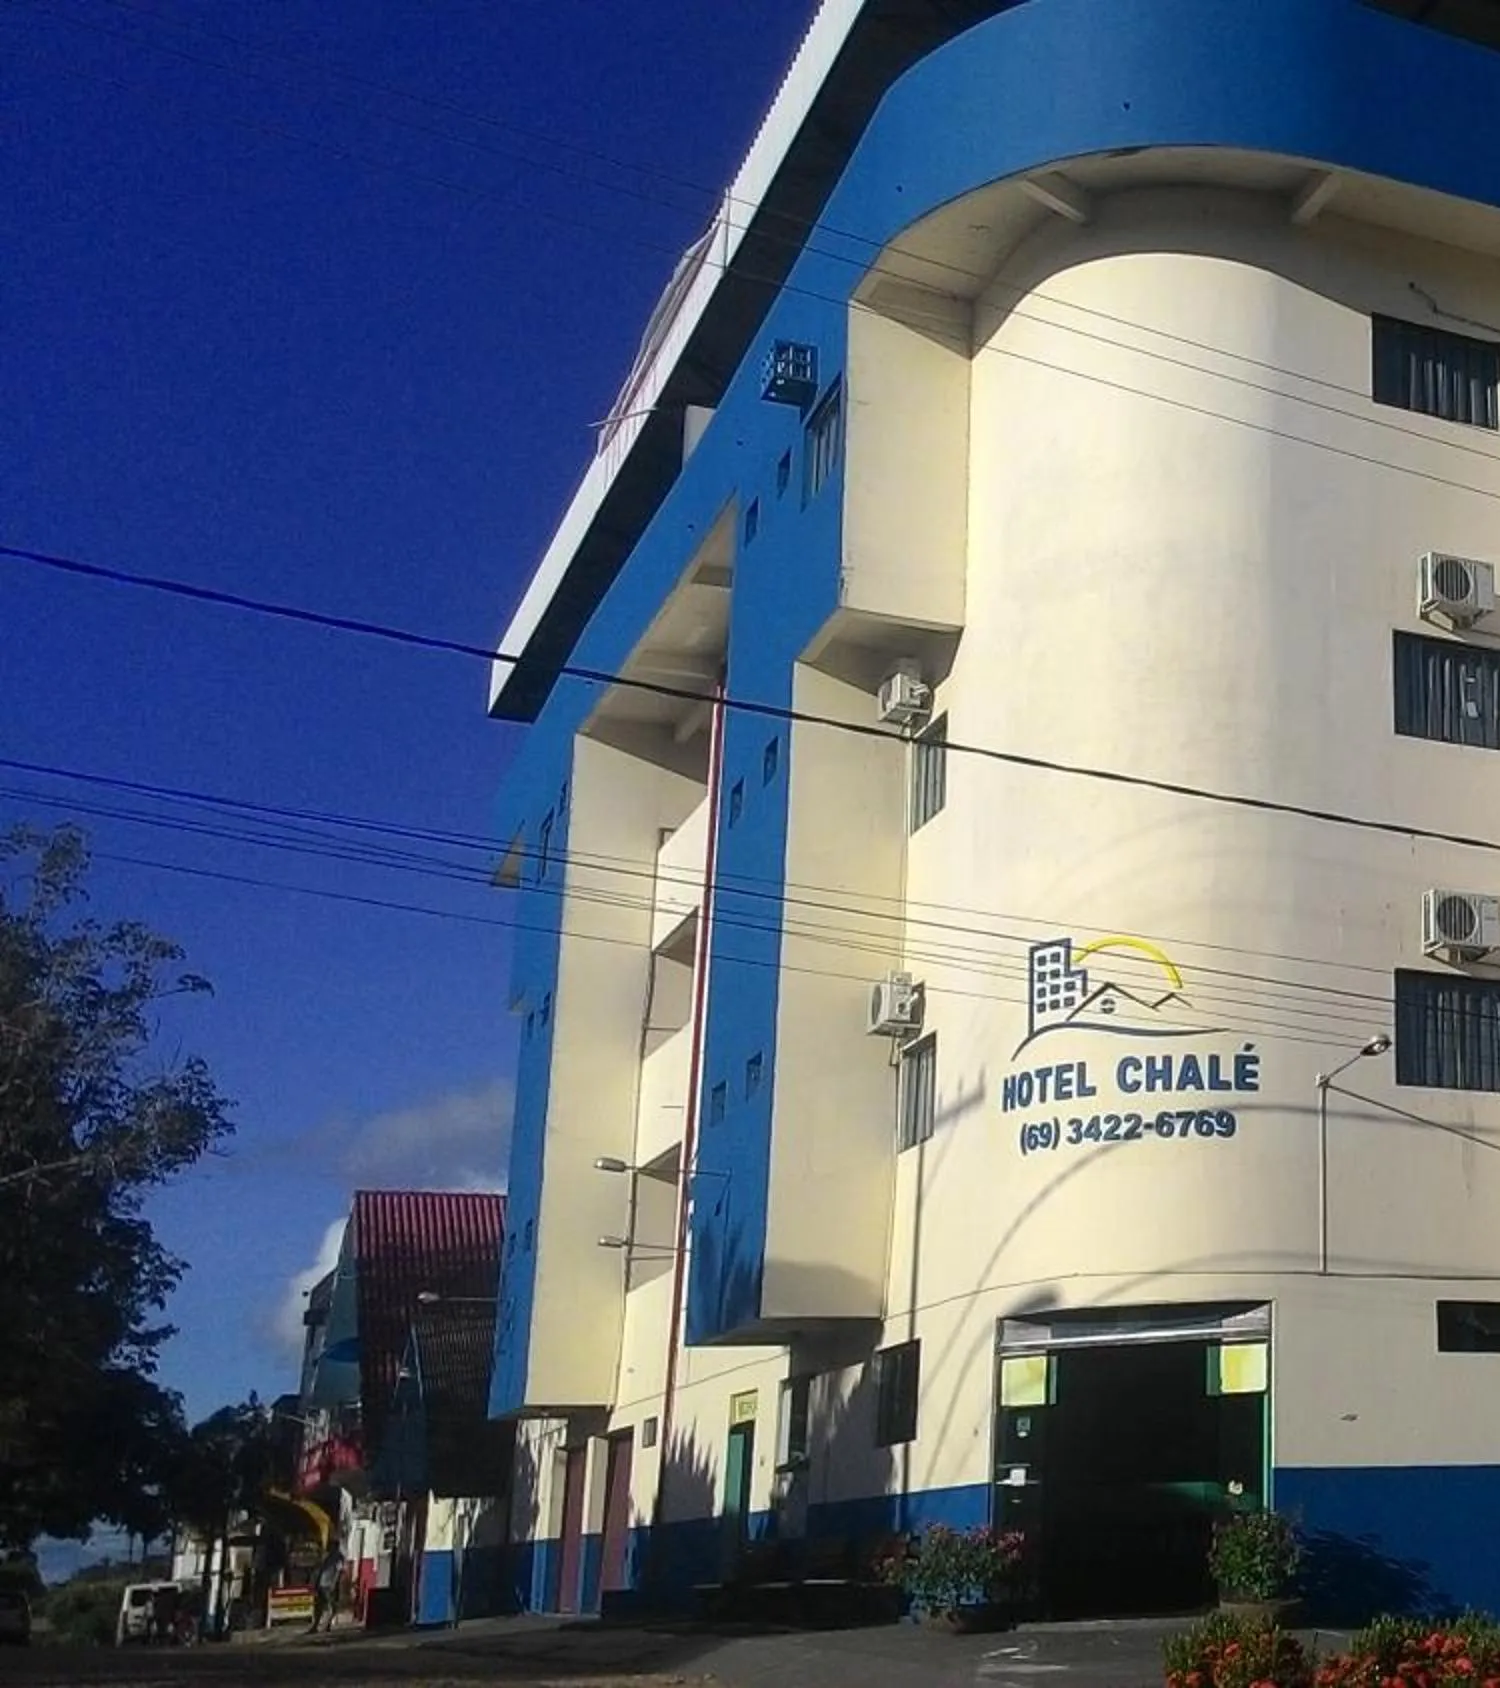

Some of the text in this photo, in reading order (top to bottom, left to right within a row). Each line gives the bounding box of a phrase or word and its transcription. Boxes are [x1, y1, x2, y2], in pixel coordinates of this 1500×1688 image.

[1002, 1043, 1260, 1112] HOTEL CHALÉ
[1020, 1110, 1236, 1155] (69) 3422-6769
